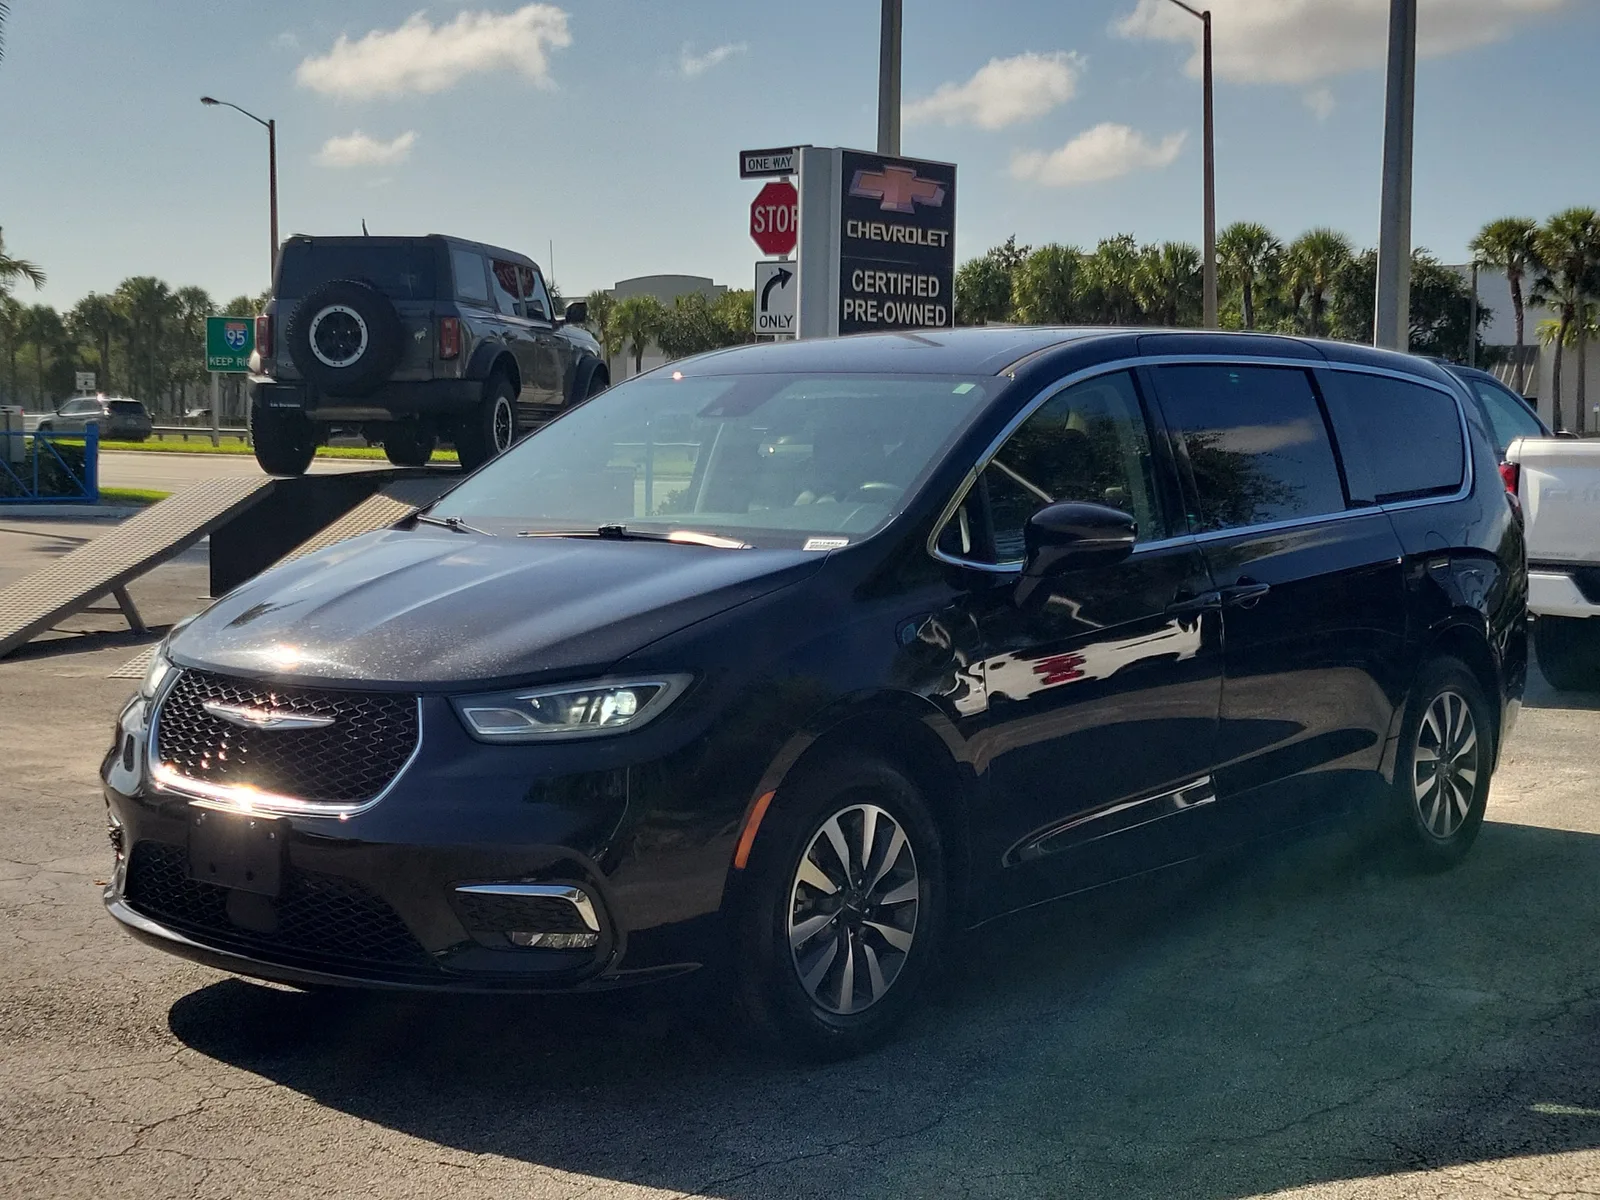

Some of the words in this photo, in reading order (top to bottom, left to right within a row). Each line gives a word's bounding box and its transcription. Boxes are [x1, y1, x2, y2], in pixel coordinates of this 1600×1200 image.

[748, 158, 770, 170] ONE
[773, 155, 793, 168] WAY
[846, 220, 949, 248] CHEVROLET
[852, 270, 940, 298] CERTIFIED
[843, 299, 947, 327] PRE-OWNED
[759, 314, 793, 329] ONLY
[227, 330, 245, 346] 95
[209, 357, 234, 366] KEEP
